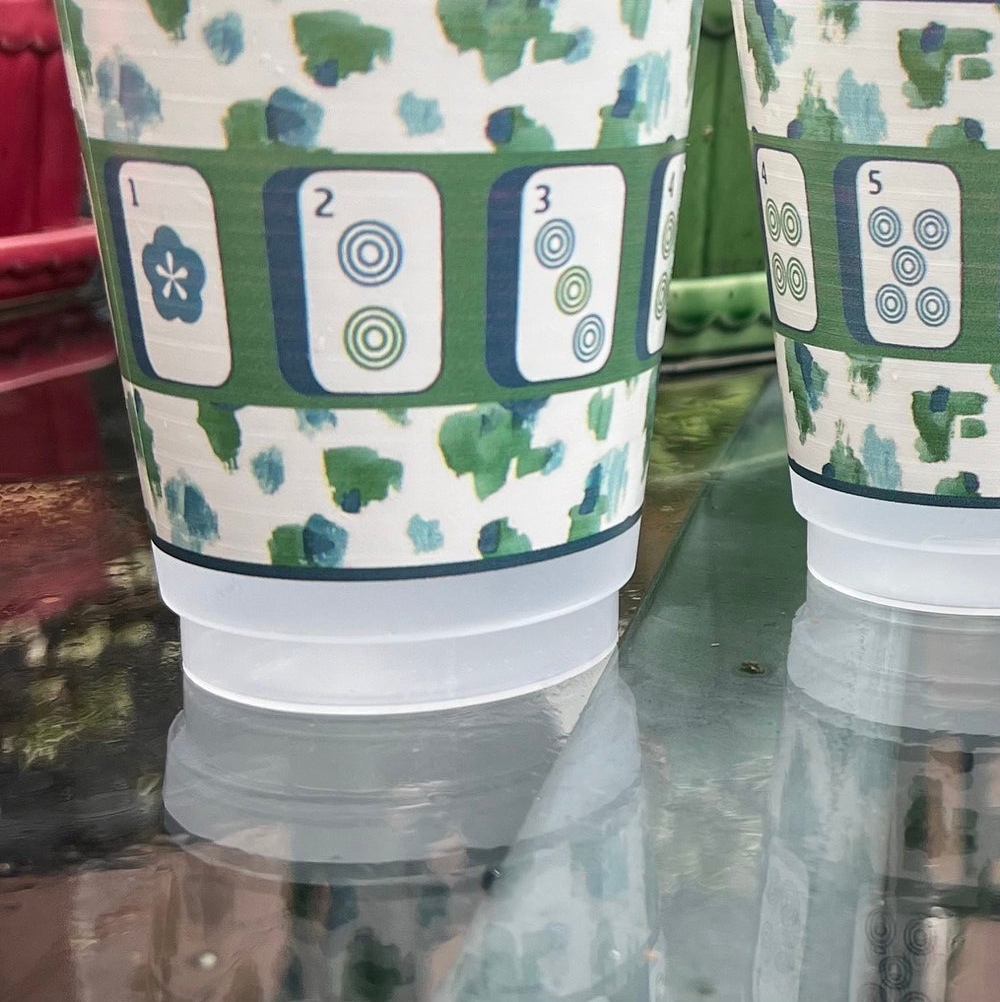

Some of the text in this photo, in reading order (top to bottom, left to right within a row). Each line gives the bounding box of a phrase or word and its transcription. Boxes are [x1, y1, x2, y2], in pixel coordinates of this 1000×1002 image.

[761, 161, 768, 185] 4
[868, 170, 882, 195] 5
[128, 178, 139, 207] 1
[314, 188, 334, 217] 2
[534, 185, 551, 213] 3
